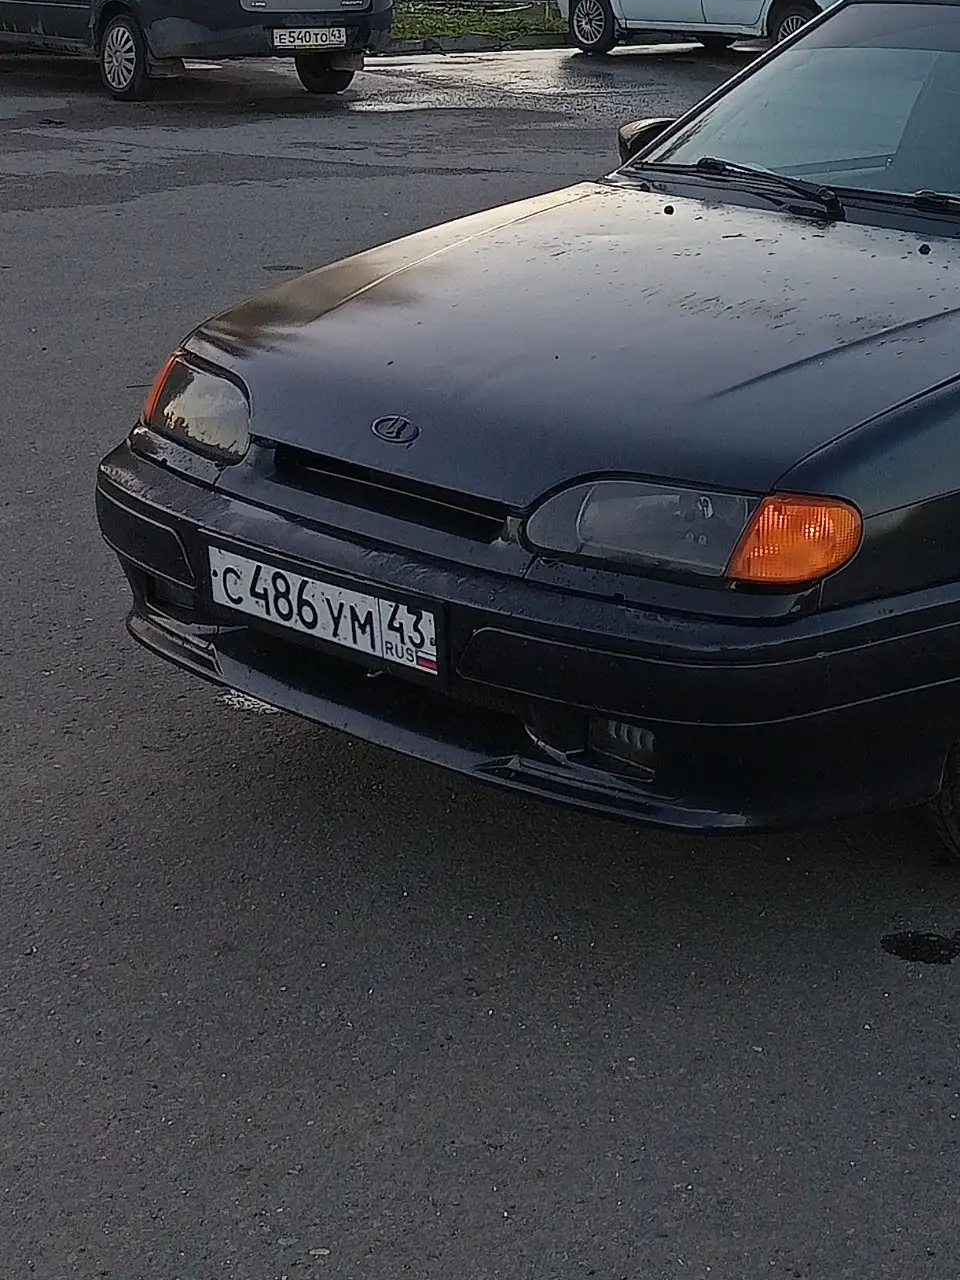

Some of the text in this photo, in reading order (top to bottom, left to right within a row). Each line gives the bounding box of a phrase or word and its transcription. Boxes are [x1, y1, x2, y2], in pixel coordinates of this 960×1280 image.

[279, 28, 342, 44] Е540ТО 43
[222, 564, 426, 652] С486УМ 43
[384, 641, 415, 663] RUS
